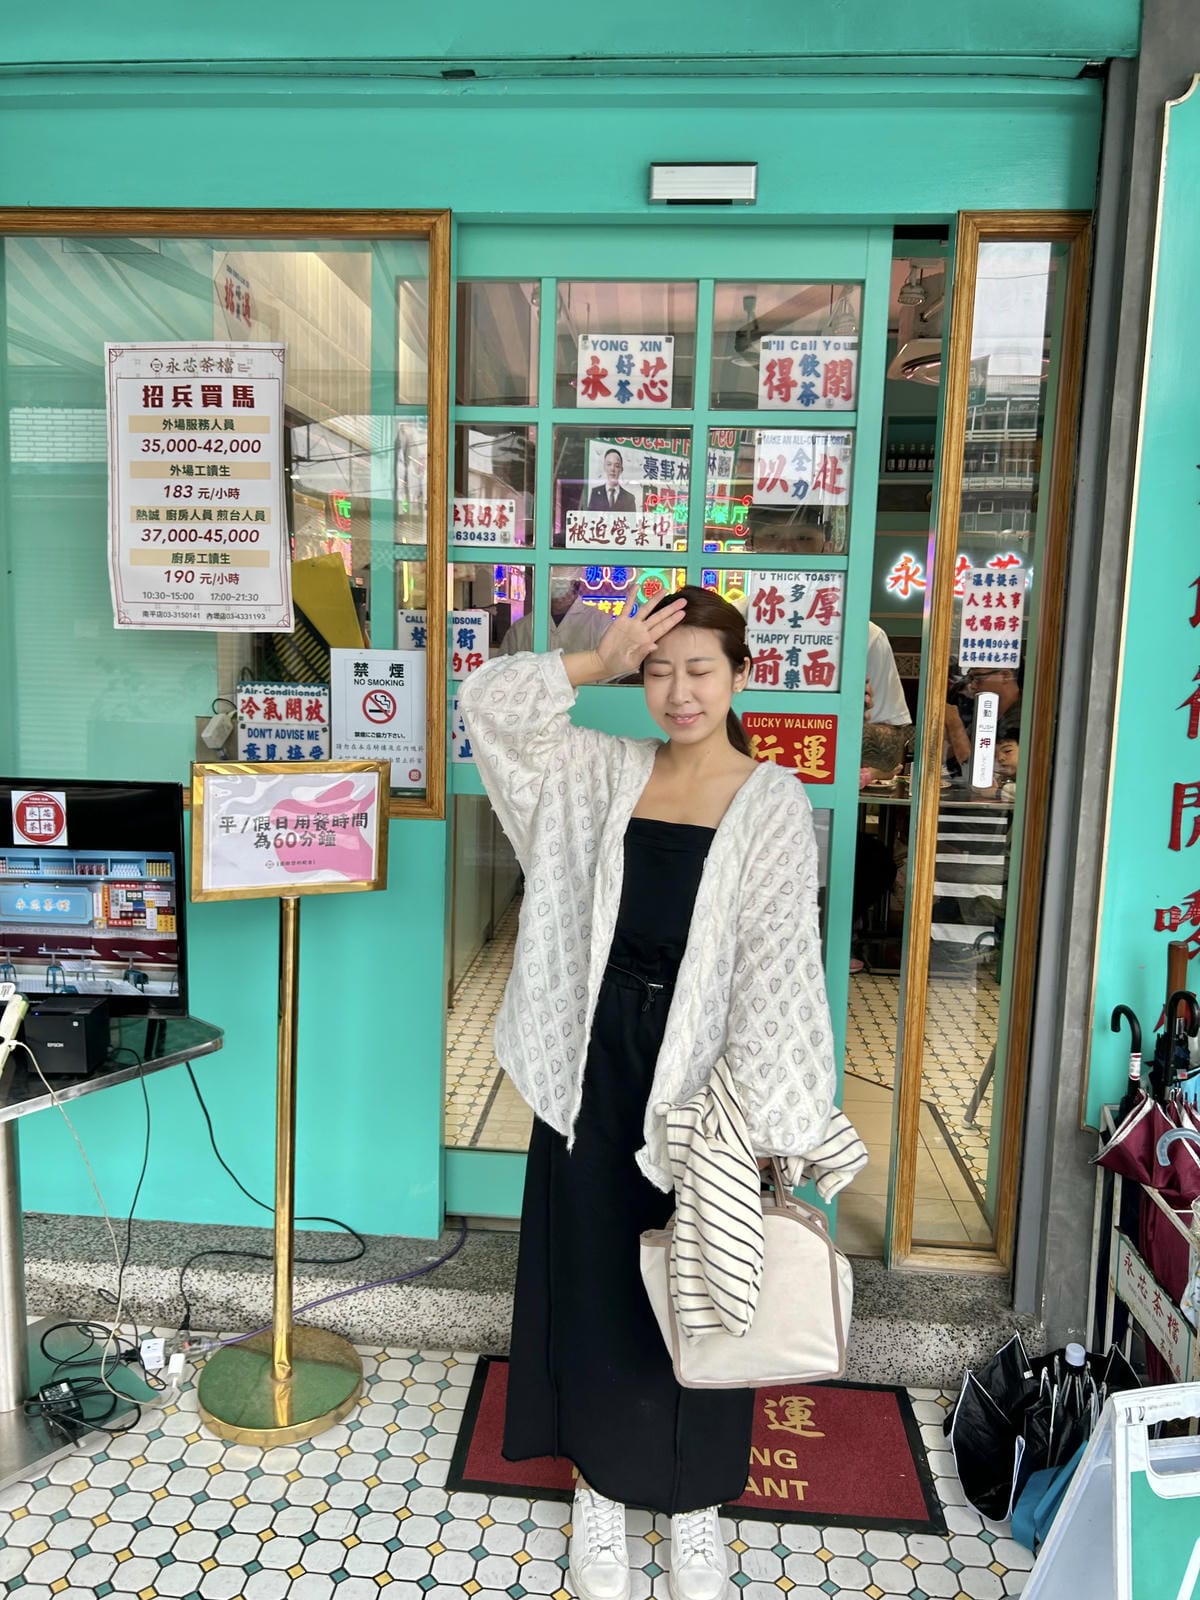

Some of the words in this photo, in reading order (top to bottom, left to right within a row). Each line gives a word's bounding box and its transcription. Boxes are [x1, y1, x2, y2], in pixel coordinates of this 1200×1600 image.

[591, 339, 629, 353] YONG
[639, 340, 662, 353] XIN
[790, 340, 817, 351] Call
[823, 340, 852, 351] You
[165, 357, 234, 374] 永芯茶檔
[581, 356, 612, 400] 永
[614, 353, 636, 404] 好茶
[637, 357, 668, 403] 芯
[763, 357, 798, 402] 得
[142, 384, 255, 409] 招兵買馬
[162, 418, 235, 432] 外場服務人員
[141, 438, 262, 455] 35,000-42,000
[169, 464, 231, 477] 外場工讀生
[757, 454, 789, 493] 以
[791, 448, 812, 501] 全力
[812, 453, 847, 495] 赴
[163, 484, 194, 499] 183
[197, 486, 241, 500] 元/小時
[165, 508, 213, 521] 廚房人員
[216, 509, 266, 522] 煎台人員
[141, 528, 260, 546] 37,000-45,000
[453, 531, 496, 541] 630433
[569, 515, 671, 547] 被迫營業中
[171, 552, 231, 565] 廚房工讀生
[163, 570, 195, 584] 190
[199, 572, 240, 586] 元/小時
[770, 573, 801, 581] THICK
[805, 573, 836, 582] TOAST
[142, 591, 195, 601] 10:30~15:00
[210, 592, 259, 602] 17:00~21:30
[966, 592, 1022, 609] 人生大事
[752, 585, 786, 625] 你
[787, 584, 806, 628] 多士
[806, 586, 841, 626] 厚
[405, 615, 424, 624] CALL
[965, 615, 1020, 632] 吃喝兩字
[756, 634, 790, 645] HAPPY
[793, 634, 833, 645] FUTURE
[752, 647, 784, 686] 前
[783, 646, 802, 690] 有樂
[803, 648, 836, 687] 面
[367, 679, 405, 687] SMOKING
[240, 695, 326, 723] 冷氣開放
[747, 716, 781, 729] LUCKY
[784, 718, 833, 730] WALKING
[247, 728, 273, 739] DON'T
[275, 729, 305, 740] ADVISE
[307, 730, 320, 741] ME
[979, 737, 992, 749] 押
[242, 743, 324, 760] 意見接受
[751, 733, 832, 778] 行運
[218, 812, 369, 834] 平/假日用餐時間
[253, 830, 337, 850] 為60分鐘
[763, 1395, 826, 1437] 運
